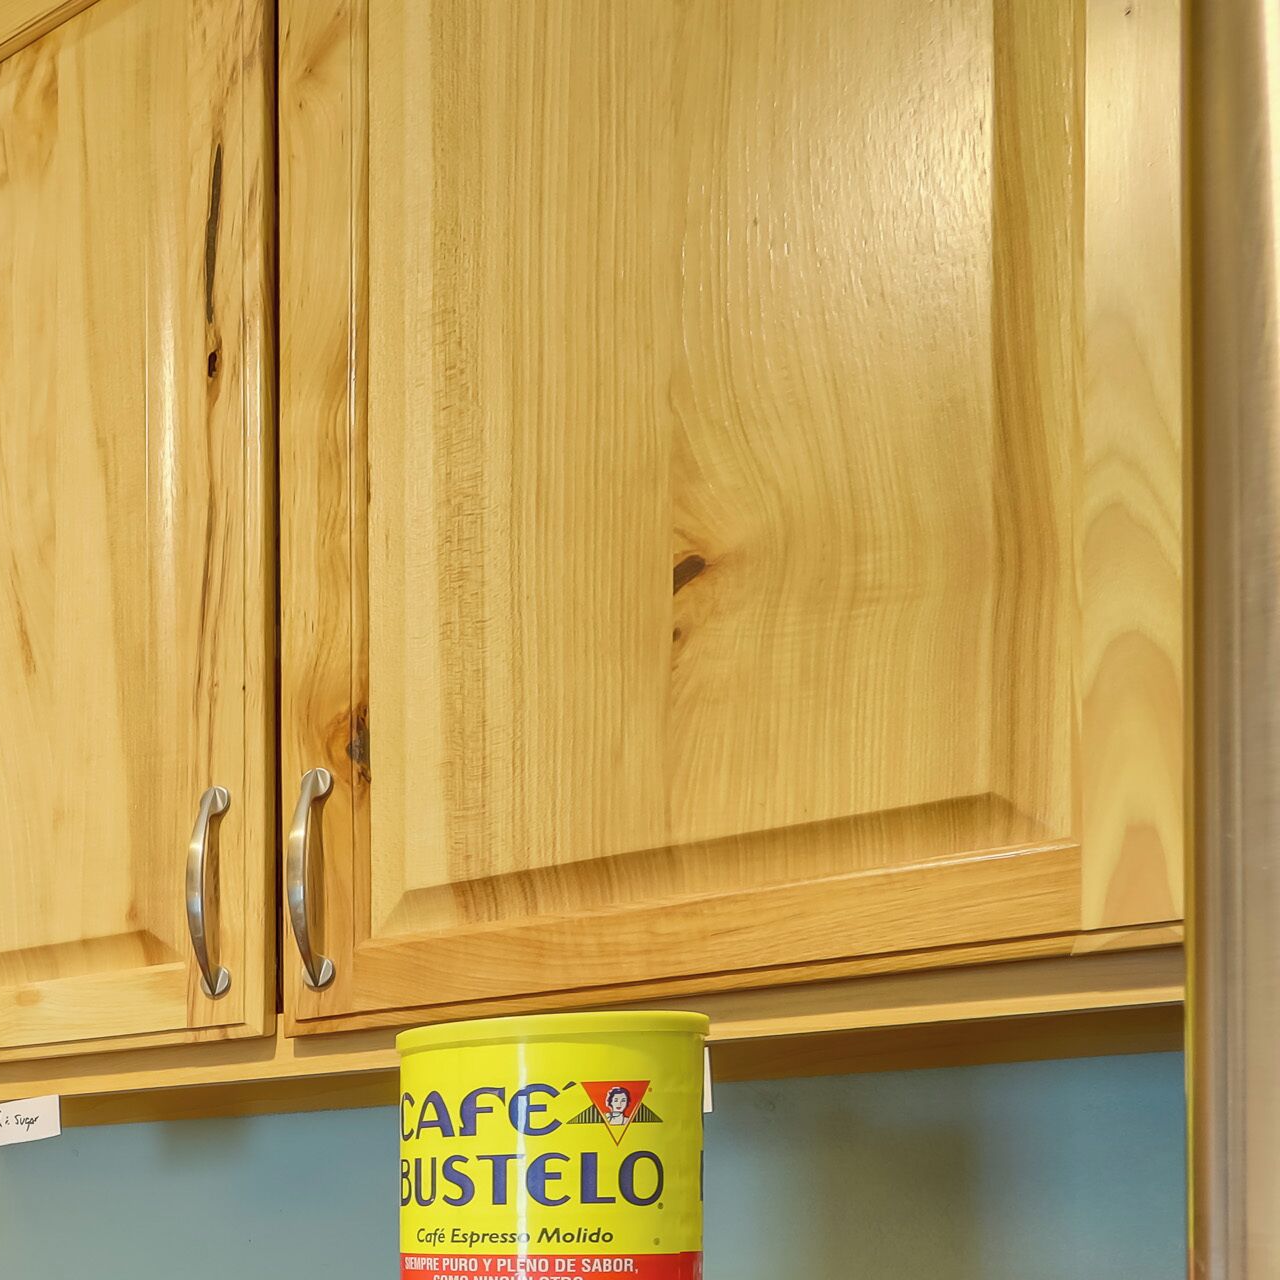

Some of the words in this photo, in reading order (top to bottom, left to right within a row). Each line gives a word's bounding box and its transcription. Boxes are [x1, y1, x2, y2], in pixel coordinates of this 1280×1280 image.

[401, 1082, 577, 1142] CAFÉ
[15, 1114, 39, 1132] Sugar
[401, 1150, 664, 1207] BUSTELO
[417, 1228, 445, 1247] Café
[451, 1229, 530, 1247] Espresso
[537, 1228, 613, 1243] Molido
[405, 1257, 439, 1270] SIEMPRE
[442, 1258, 477, 1271] PURO
[482, 1259, 491, 1271] Y
[497, 1259, 548, 1272] PLENO
[555, 1259, 576, 1272] DE
[581, 1259, 639, 1274] SABOR,
